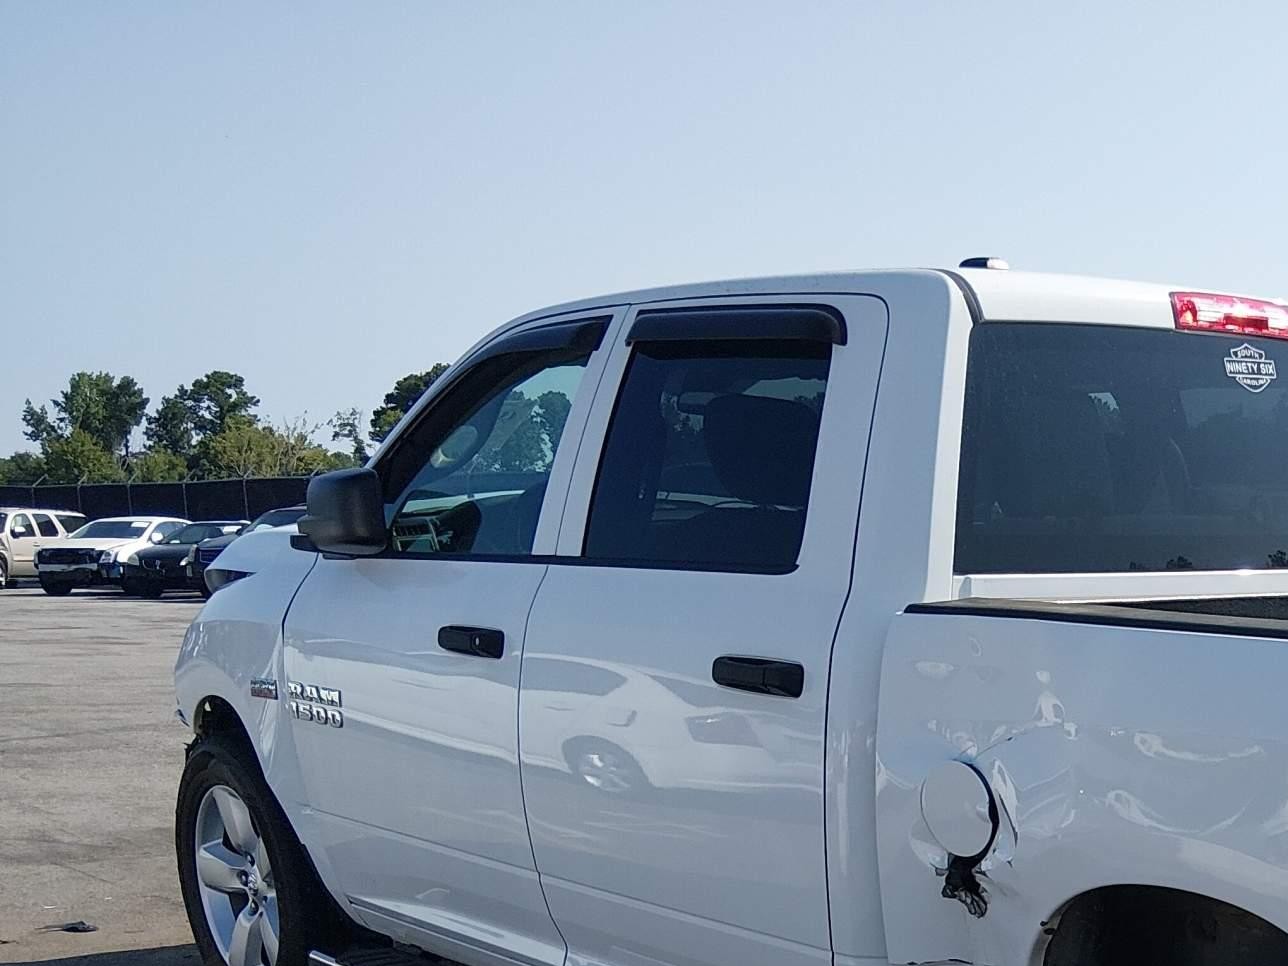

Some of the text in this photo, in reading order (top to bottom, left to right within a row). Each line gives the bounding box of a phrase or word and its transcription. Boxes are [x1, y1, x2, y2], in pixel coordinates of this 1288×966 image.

[1237, 348, 1260, 360] SOUTH
[1226, 361, 1274, 375] NINETY SIX
[287, 680, 342, 708] RAM
[288, 701, 344, 728] 1500
